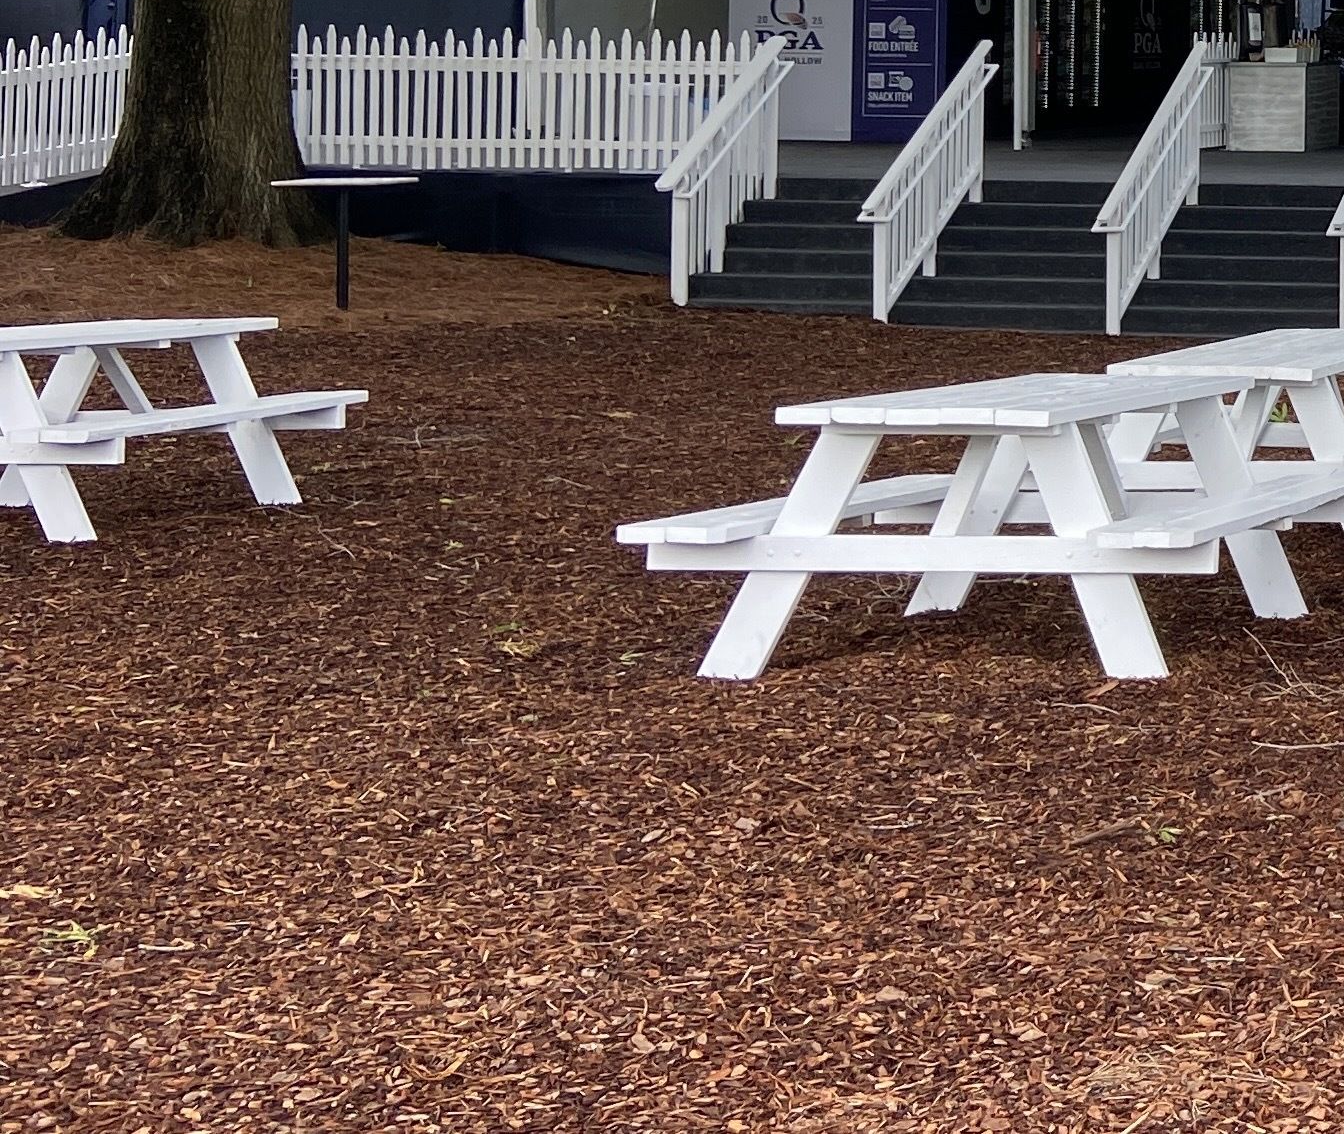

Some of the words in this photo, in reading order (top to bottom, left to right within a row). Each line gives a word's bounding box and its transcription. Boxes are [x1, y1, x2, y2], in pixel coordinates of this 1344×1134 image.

[757, 16, 769, 24] 20
[812, 17, 823, 25] 25
[868, 41, 889, 52] FOOD
[890, 40, 919, 52] ENTRÉE
[1133, 32, 1162, 53] PGA
[867, 91, 894, 102] SNACK
[895, 91, 913, 102] ITEM
